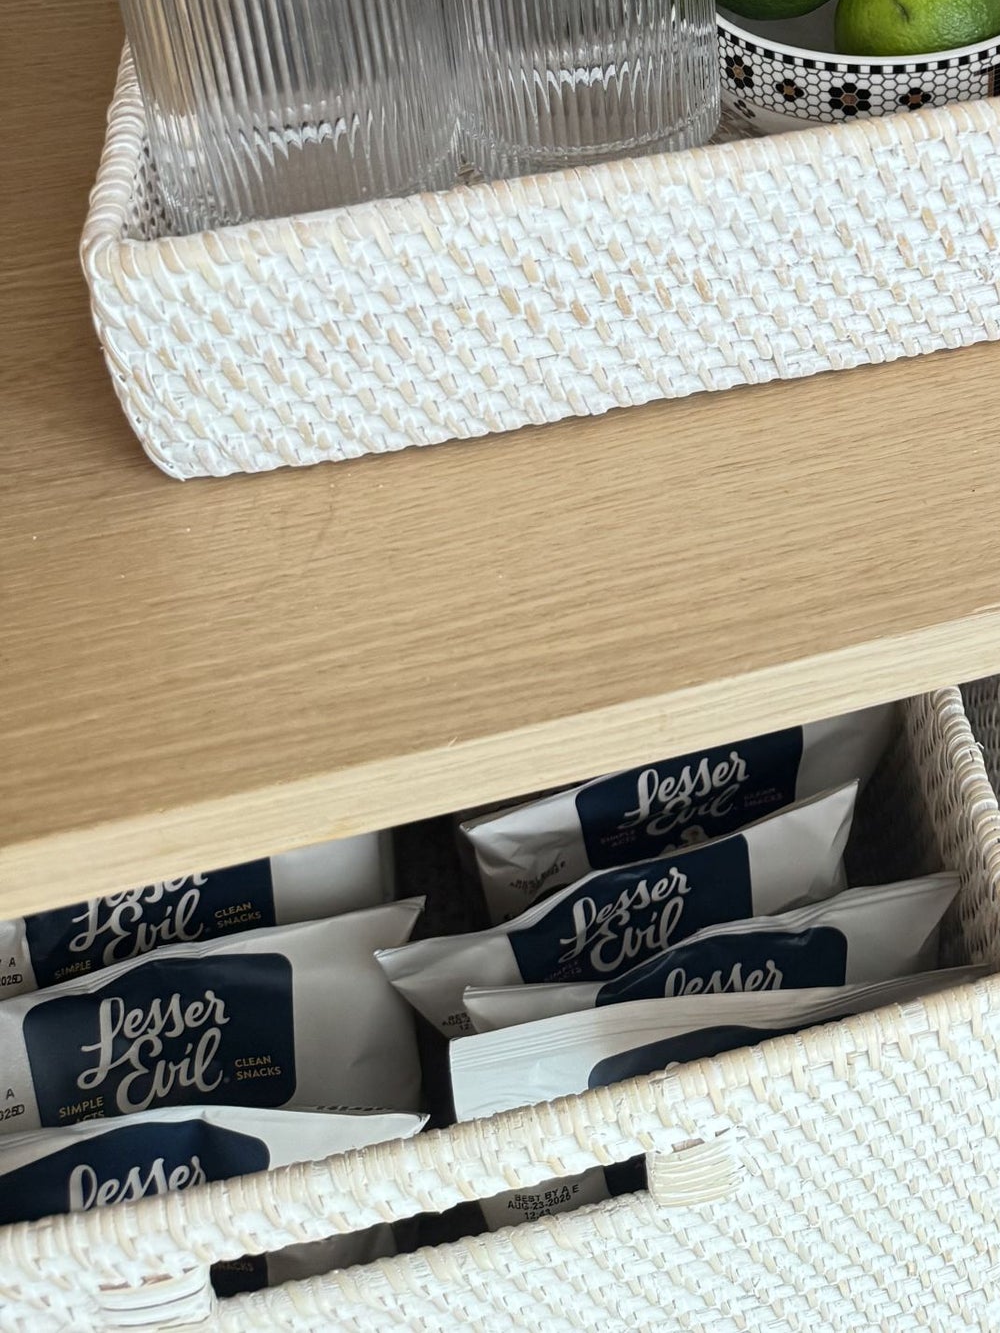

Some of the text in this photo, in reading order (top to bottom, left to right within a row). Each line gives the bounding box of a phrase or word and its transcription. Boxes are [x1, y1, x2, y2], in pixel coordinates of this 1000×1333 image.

[617, 751, 750, 830] Lesser
[646, 783, 740, 836] Evil
[102, 888, 204, 967] Evil
[214, 902, 252, 919] CLEAN
[217, 911, 262, 928] SNACKS
[558, 866, 692, 963] Lesser
[590, 896, 684, 972] Evil
[77, 990, 232, 1090] Lesser
[234, 1055, 272, 1068] CLEAN
[116, 1027, 224, 1114] Evil
[235, 1066, 282, 1081] SNACKS
[58, 1096, 104, 1118] SIMPLE
[514, 1194, 541, 1203] BEST
